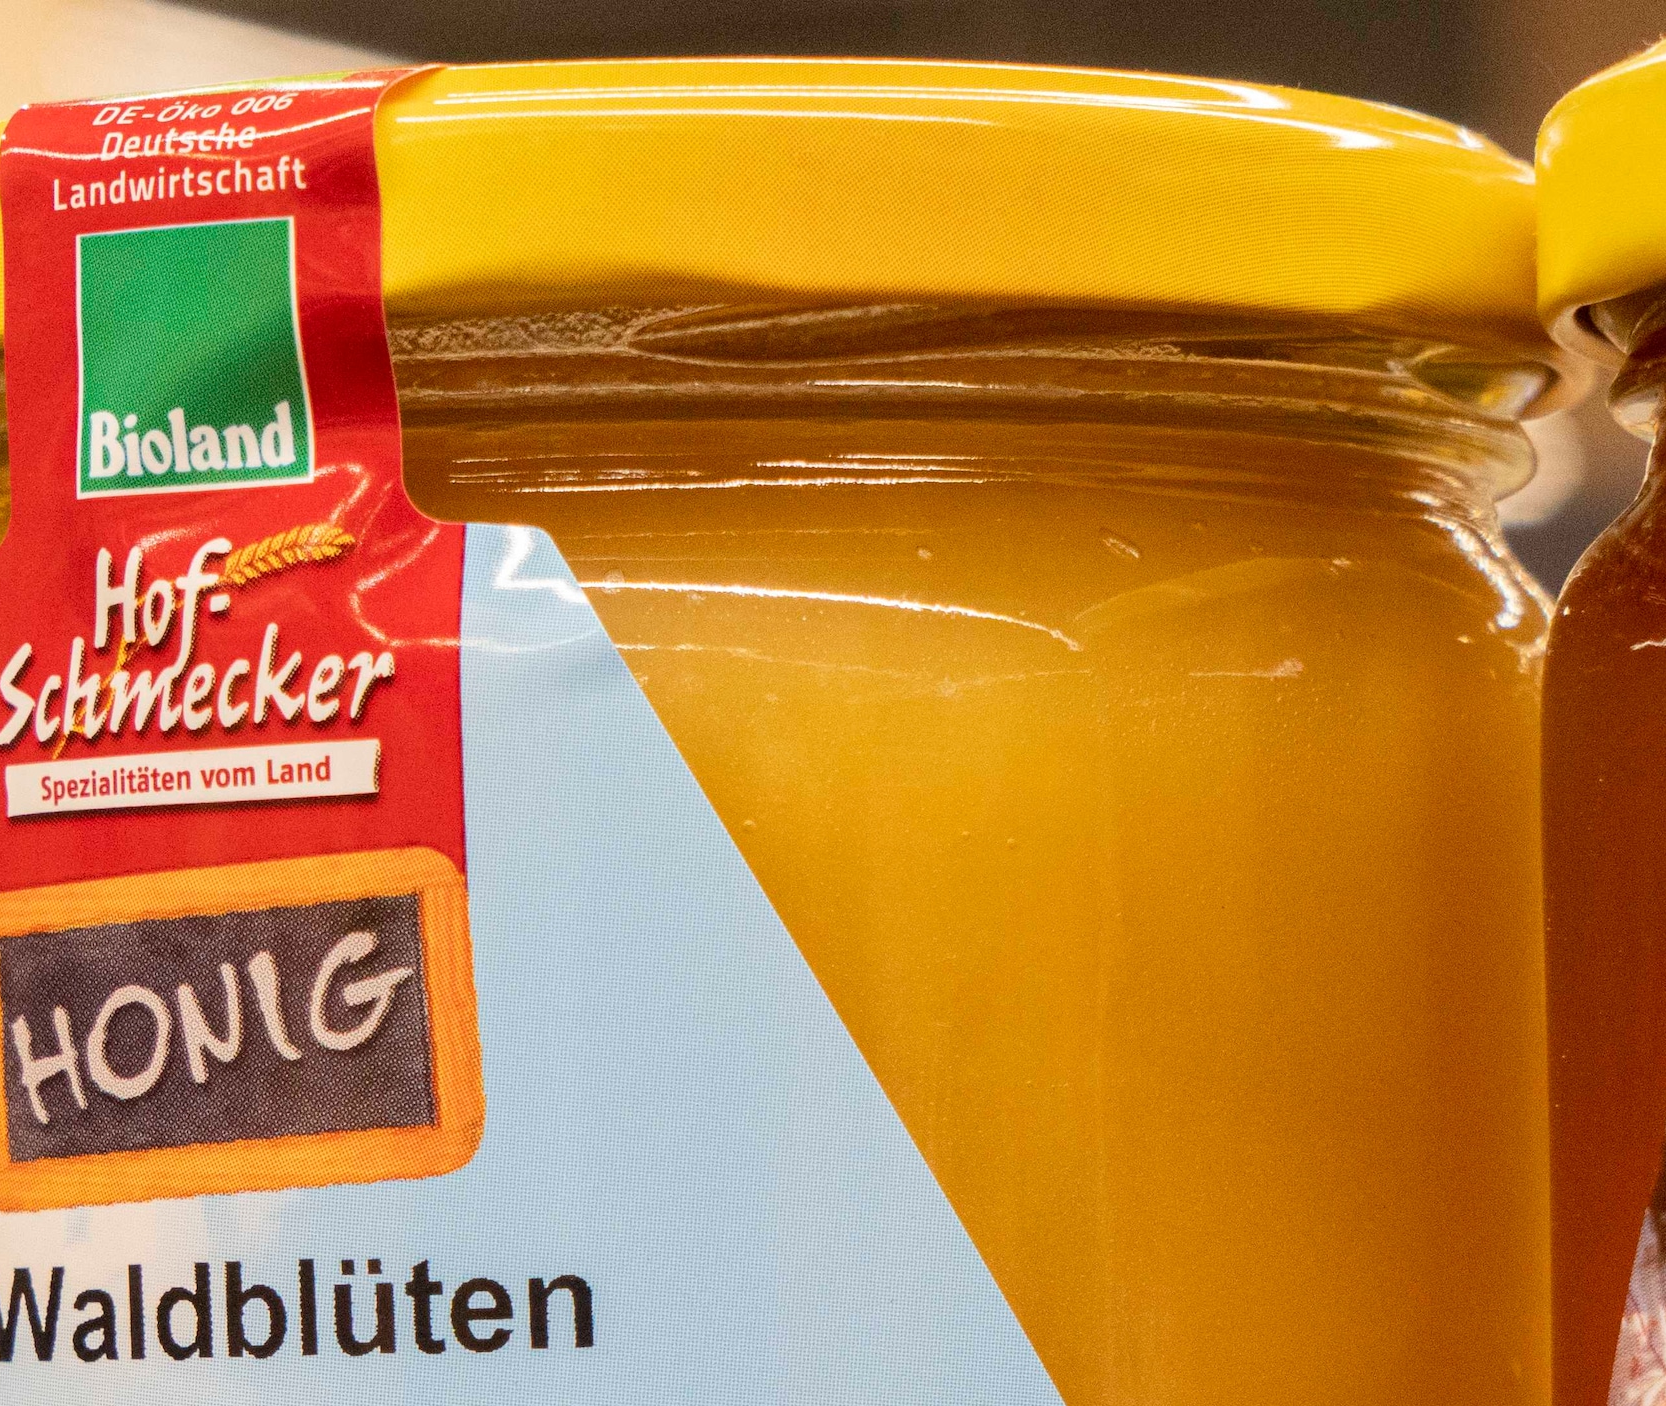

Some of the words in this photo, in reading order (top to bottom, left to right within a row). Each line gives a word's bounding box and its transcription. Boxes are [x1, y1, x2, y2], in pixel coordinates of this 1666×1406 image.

[91, 100, 226, 127] DE-Öko
[230, 92, 300, 116] 006
[100, 123, 258, 162] Deutsche
[53, 157, 309, 211] Landwirtschaft
[89, 400, 297, 479] Bioland
[40, 765, 193, 804] Spezialitäten
[200, 764, 258, 789] vom
[266, 755, 332, 785] Land
[10, 930, 414, 1125] HONIG
